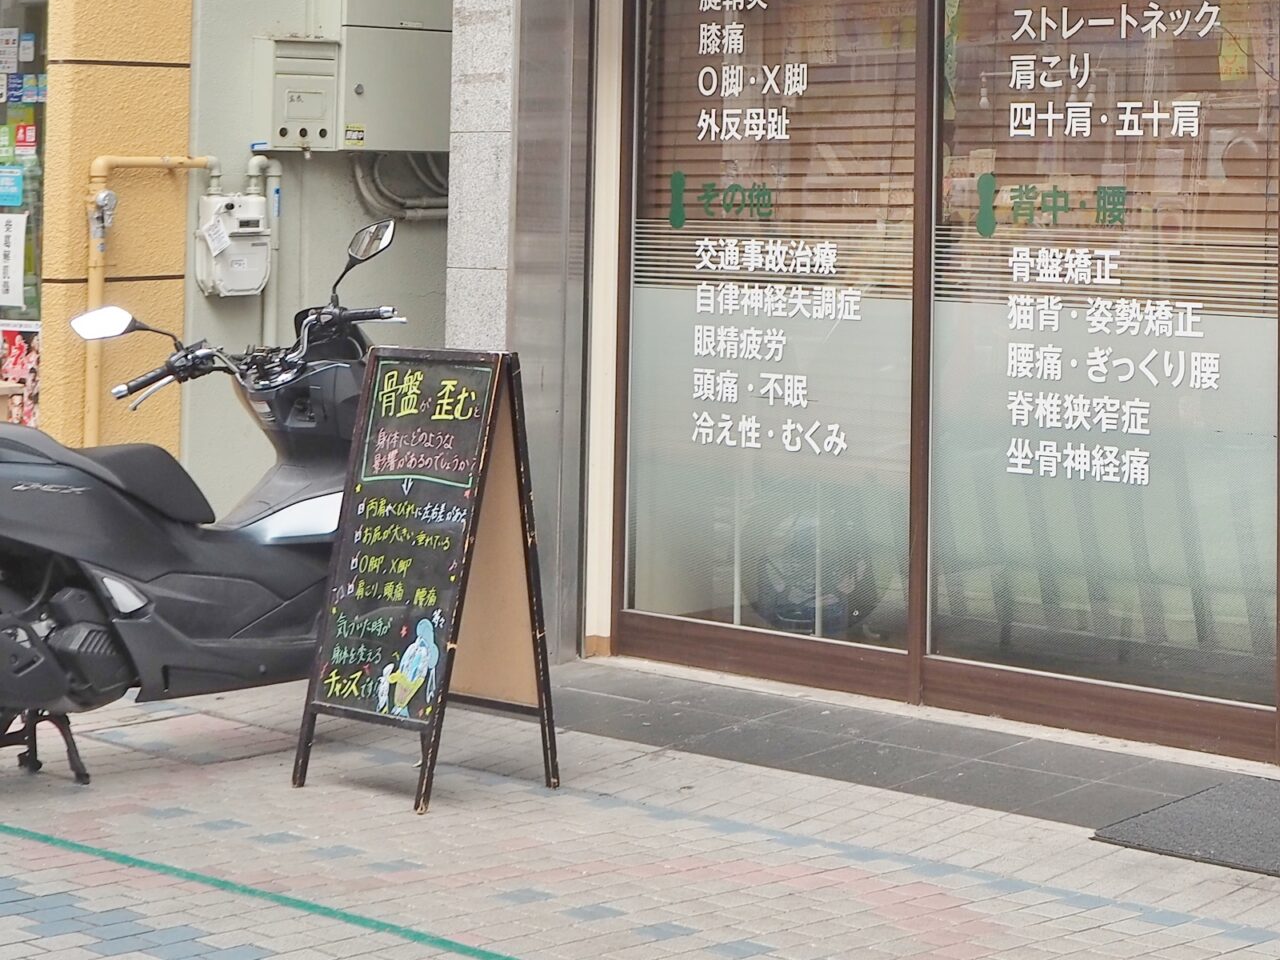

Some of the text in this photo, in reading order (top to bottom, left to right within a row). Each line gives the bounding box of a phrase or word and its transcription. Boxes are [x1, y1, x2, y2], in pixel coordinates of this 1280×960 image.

[698, 21, 745, 55] 膝痛
[1010, 0, 1221, 41] ストレートネック
[1008, 52, 1091, 90] 肩こり
[697, 107, 791, 141] 外反母趾
[1009, 99, 1202, 138] 四十肩・五十肩
[697, 182, 772, 218] その他
[1010, 184, 1126, 225] 背中・腰
[695, 237, 838, 274] 交通事故治療
[1008, 247, 1121, 285] 骨盤矯正
[695, 282, 862, 321] 自律神経失調症
[1008, 295, 1204, 338] 猫背・姿勢矯正
[694, 325, 787, 362] 眼精疲労
[1006, 342, 1221, 390] 腰痛・ぎっくり腰
[692, 367, 808, 408] 頭痛・不眠
[1006, 390, 1150, 435] 脊椎狭窄症
[691, 411, 848, 456] 冷え性・むくみ
[1006, 438, 1150, 486] 坐骨神経痛
